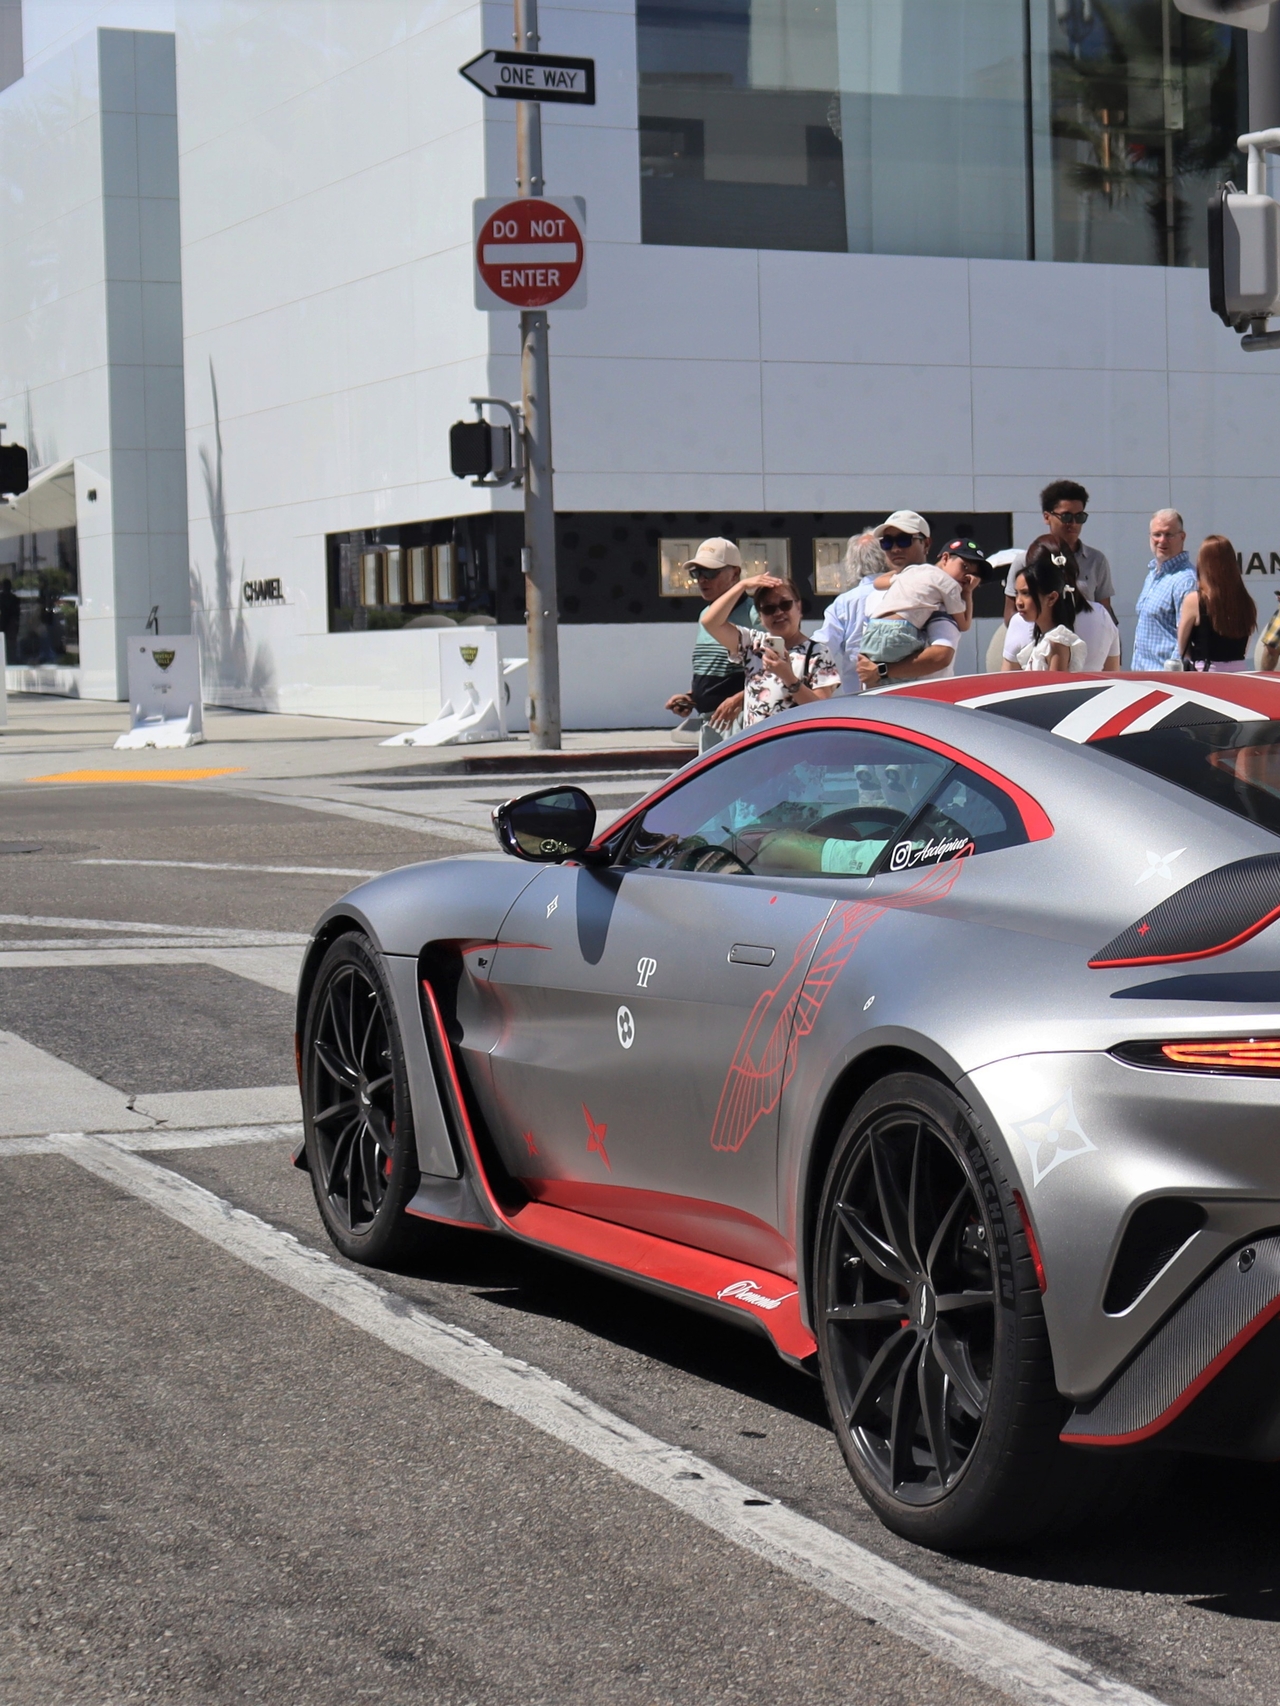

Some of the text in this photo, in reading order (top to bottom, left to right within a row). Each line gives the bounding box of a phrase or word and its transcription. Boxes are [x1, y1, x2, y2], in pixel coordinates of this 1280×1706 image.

[500, 66, 577, 89] ONE WAY
[492, 219, 566, 238] DO NOT
[501, 268, 560, 288] ENTER
[243, 577, 284, 602] CHANEL
[968, 1146, 1015, 1300] MICHELIN
